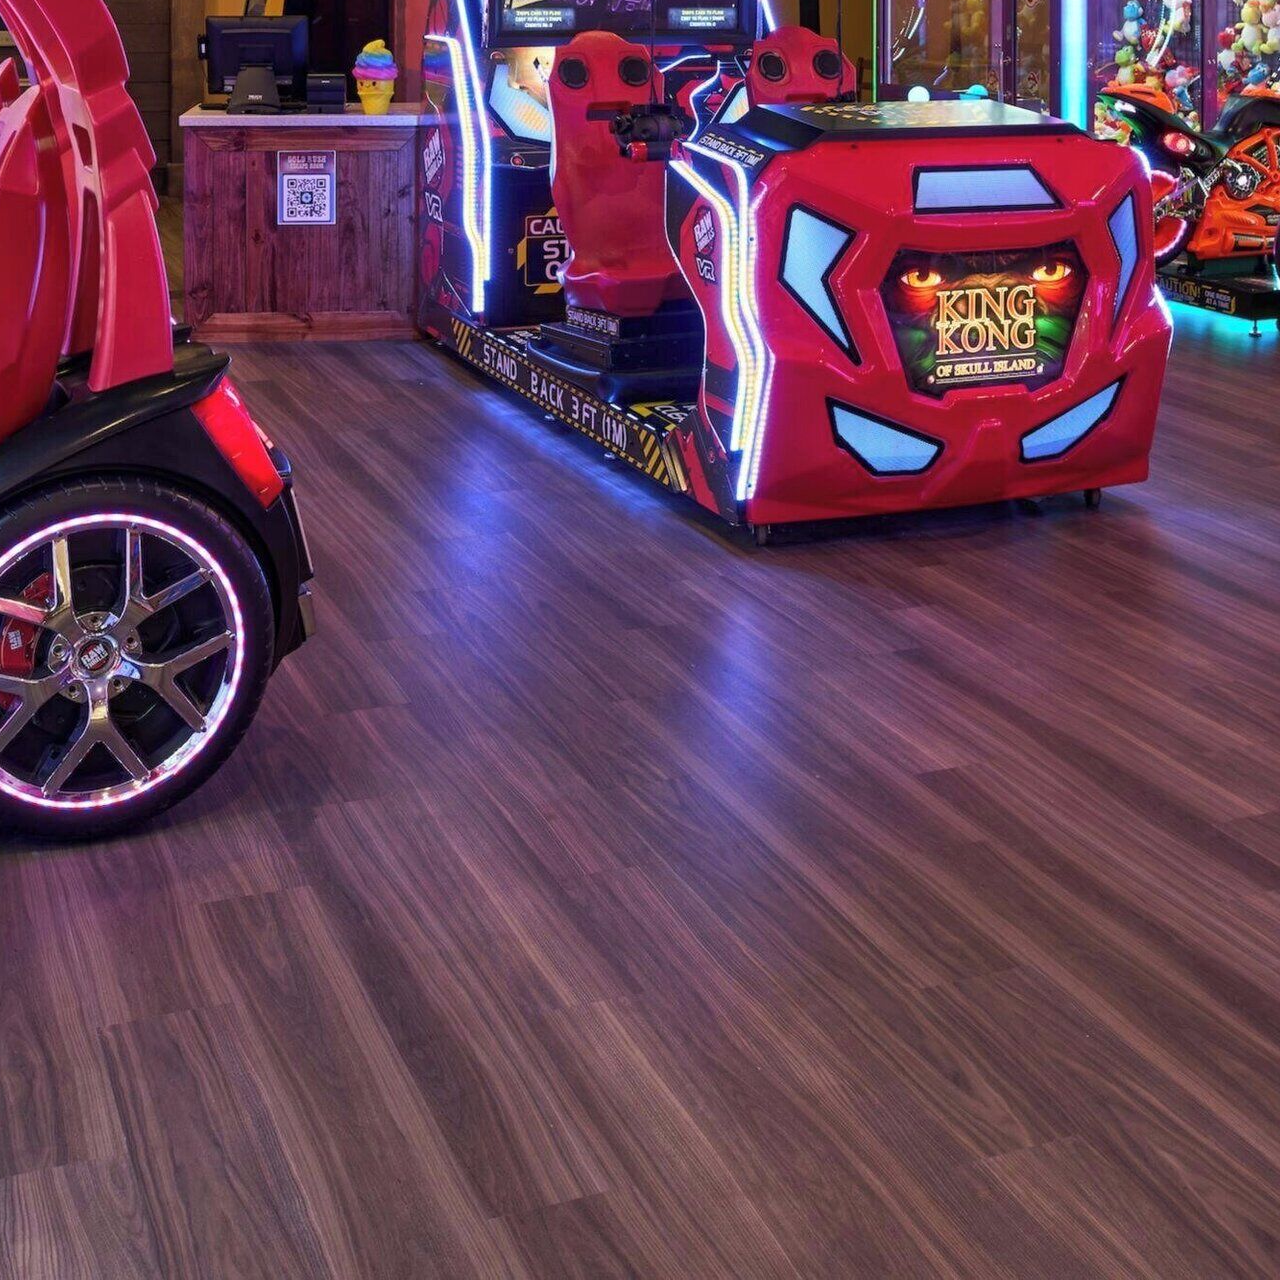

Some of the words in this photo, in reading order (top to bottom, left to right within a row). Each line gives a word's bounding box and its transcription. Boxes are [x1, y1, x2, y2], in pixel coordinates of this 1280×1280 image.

[287, 155, 306, 164] GOLD
[698, 135, 722, 151] STAND
[718, 143, 737, 157] BACK
[693, 210, 714, 241] RAW
[696, 256, 717, 283] VR
[936, 285, 1037, 325] KING
[936, 318, 1037, 355] KONG
[936, 365, 953, 378] OF
[954, 361, 993, 376] SKULL
[993, 359, 1037, 373] ISLAND
[483, 343, 518, 381] STAND
[530, 371, 564, 411] BACK
[602, 412, 628, 451] (1M)
[81, 643, 109, 666] RAW
